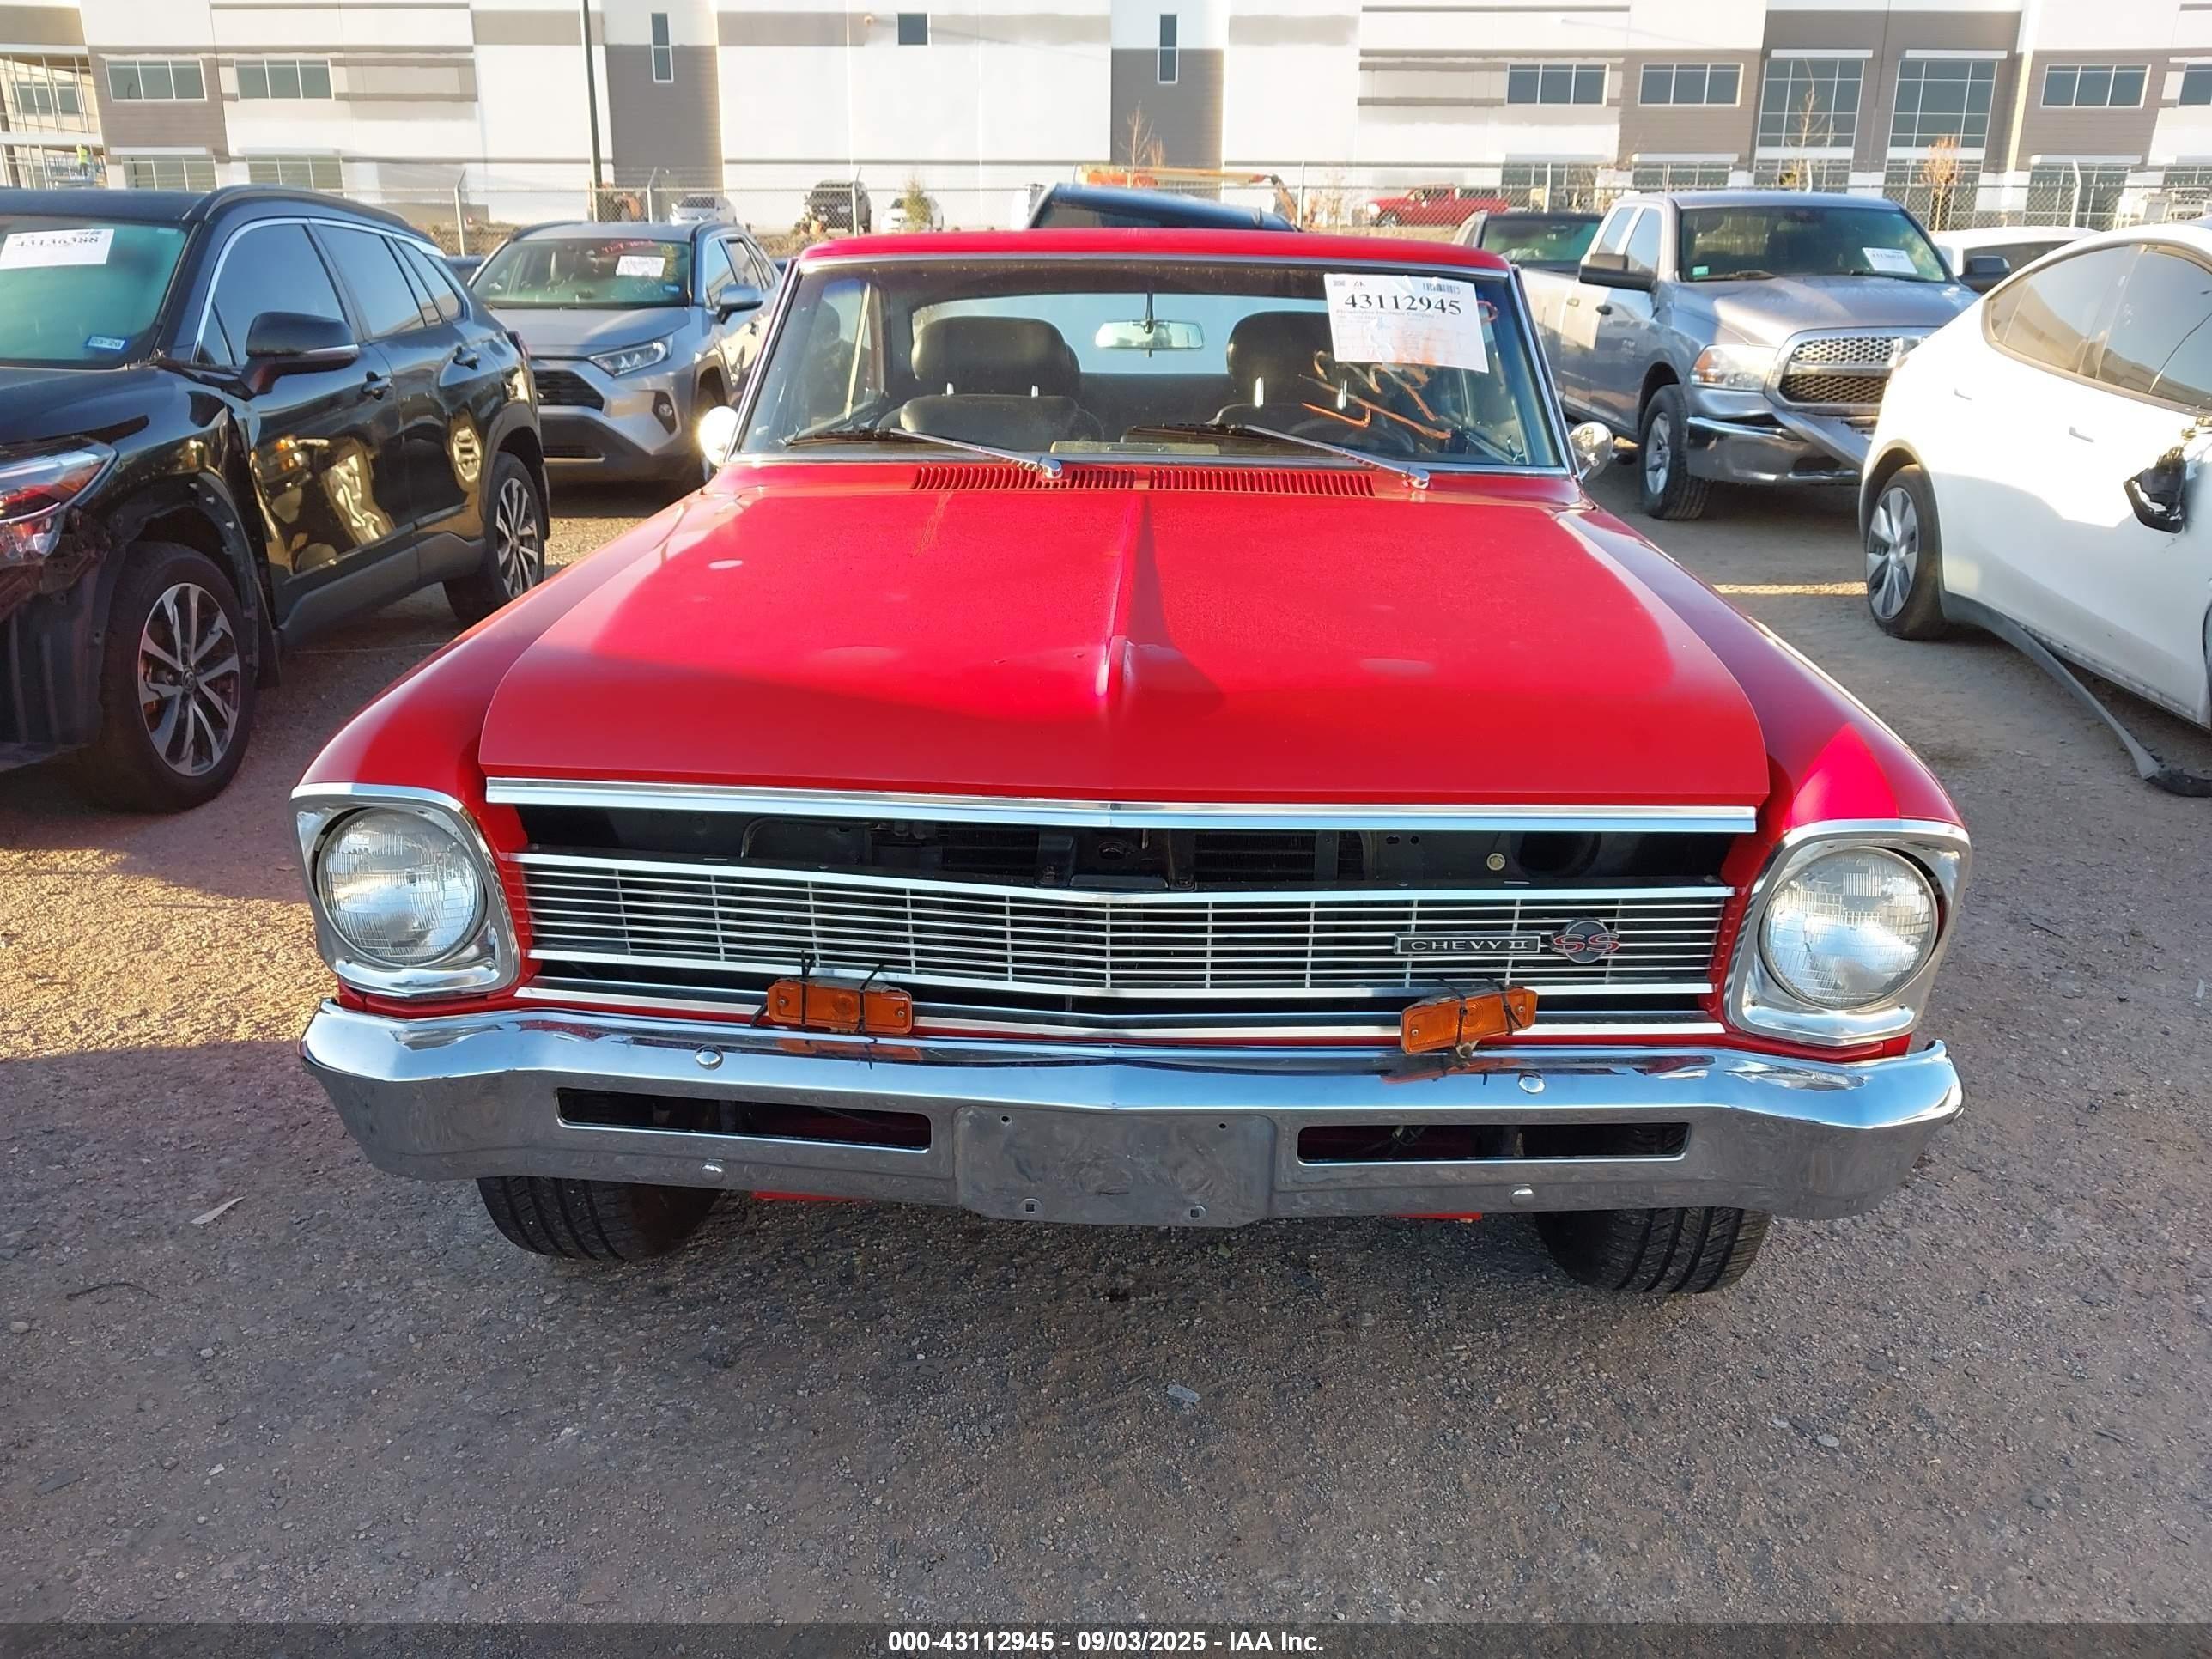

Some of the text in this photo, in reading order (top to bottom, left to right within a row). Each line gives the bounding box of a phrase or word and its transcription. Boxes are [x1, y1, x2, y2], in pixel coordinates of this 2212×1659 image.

[1345, 293, 1462, 316] 43112945
[1410, 940, 1502, 951] CHEVY
[1551, 933, 1621, 954] SS
